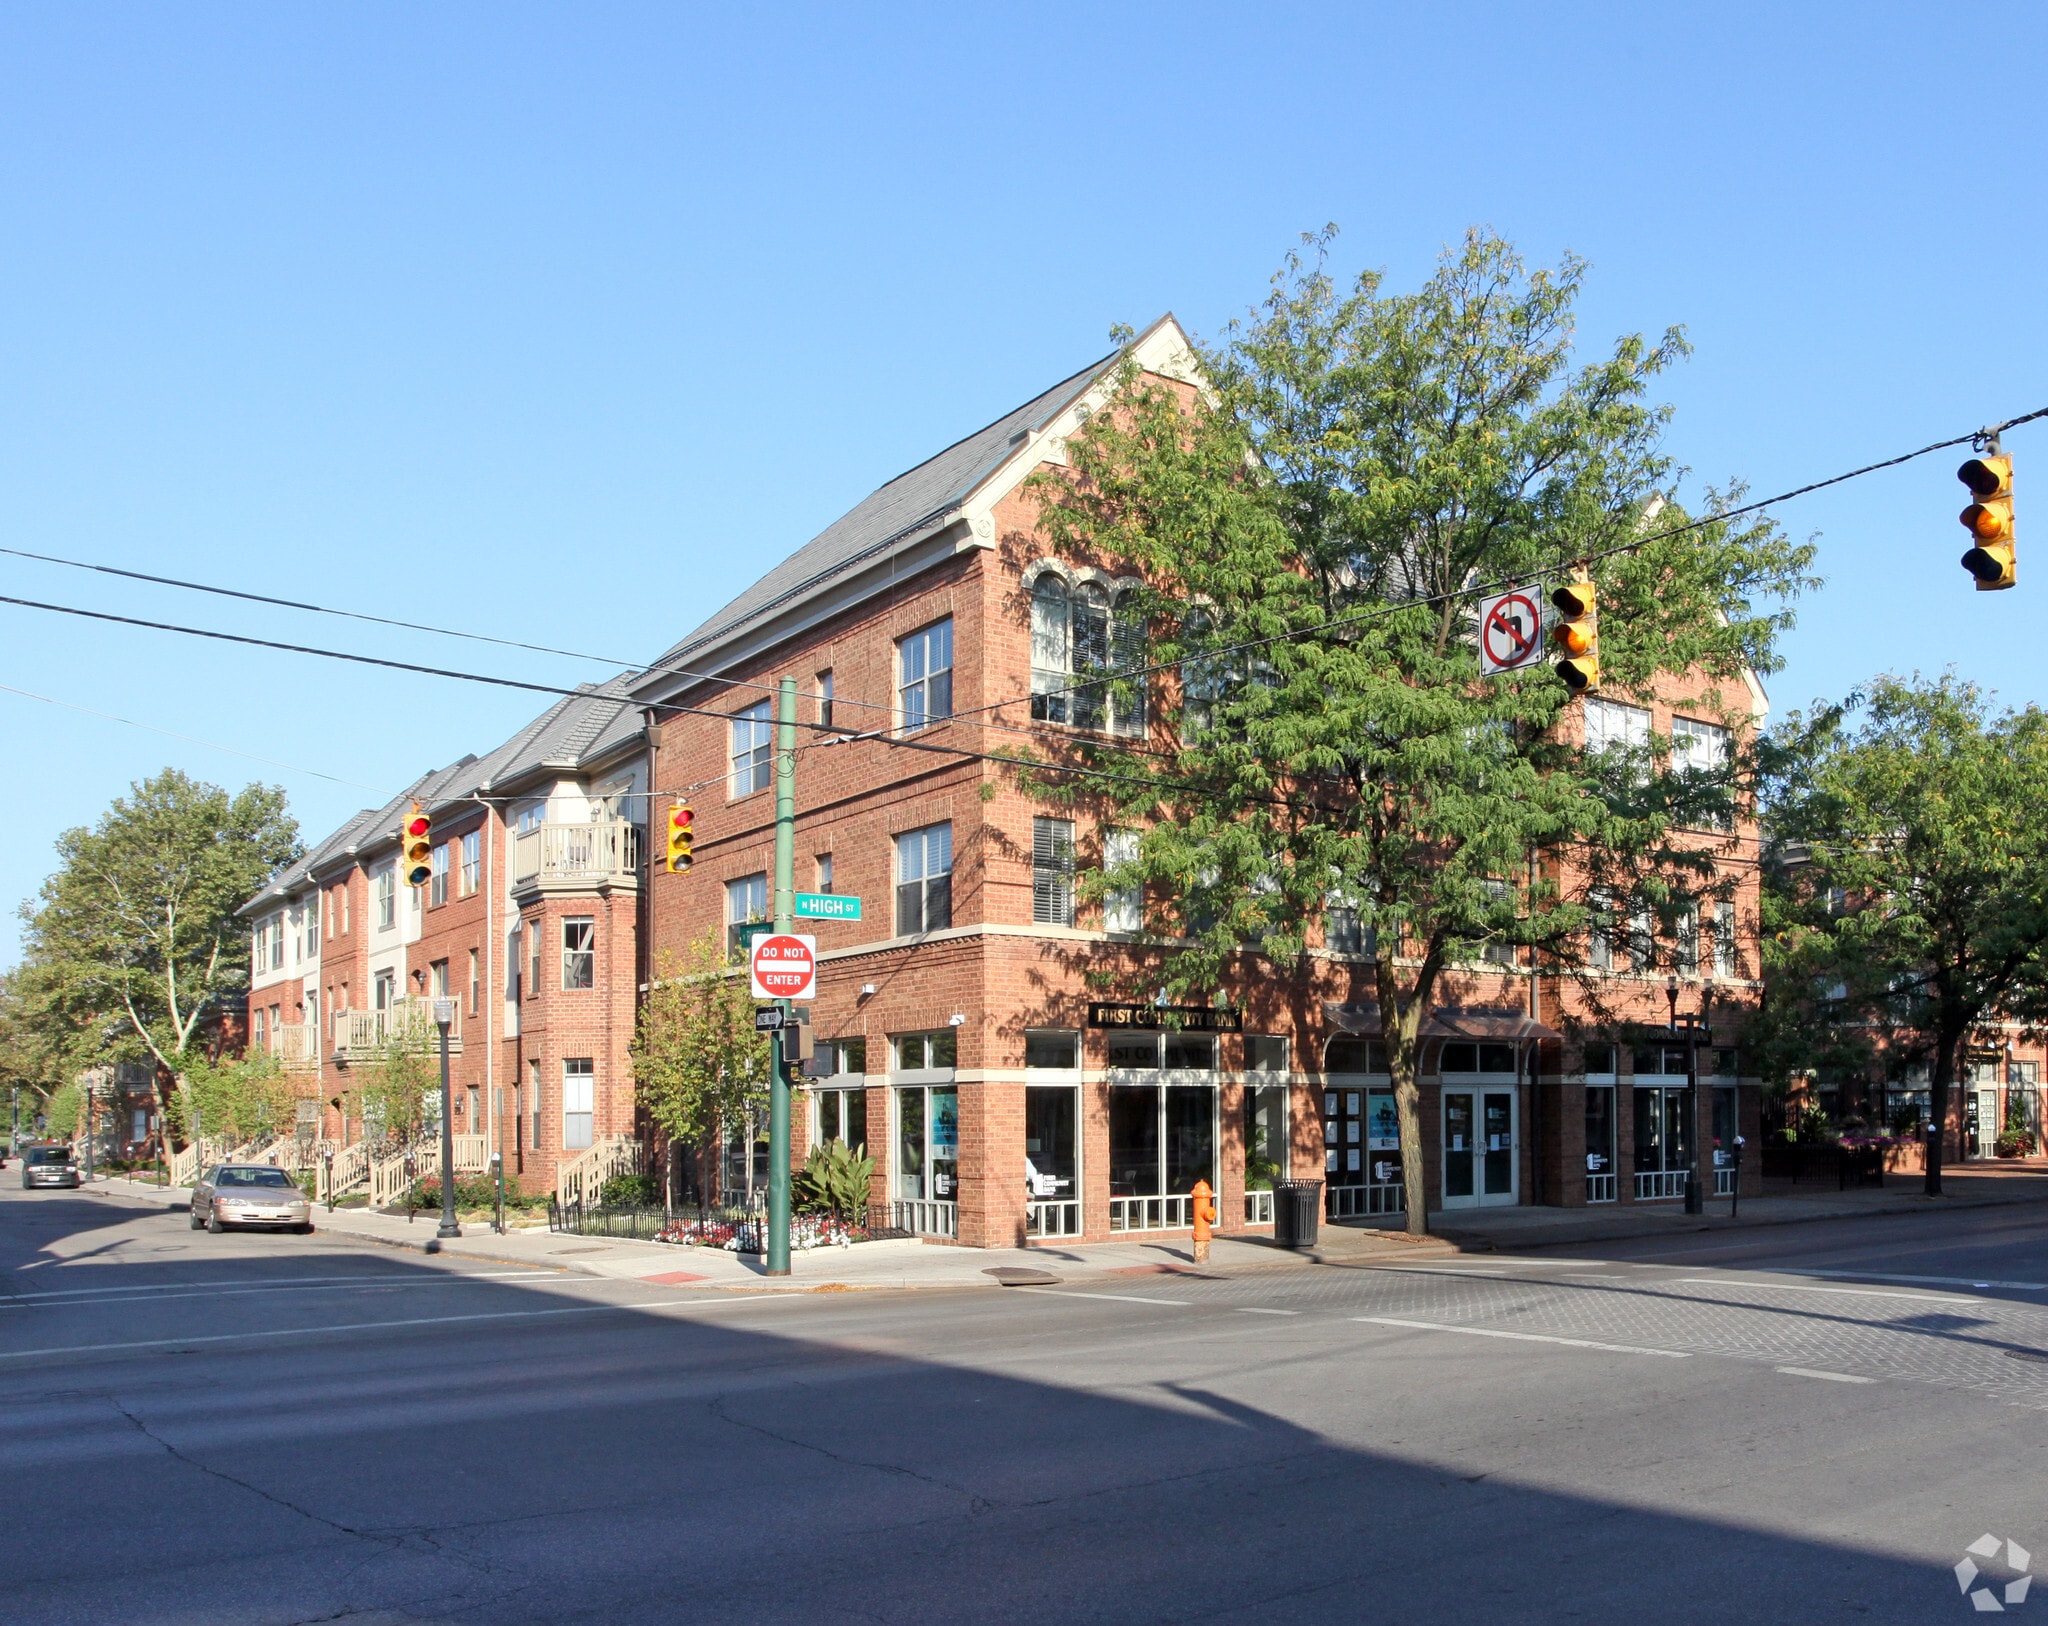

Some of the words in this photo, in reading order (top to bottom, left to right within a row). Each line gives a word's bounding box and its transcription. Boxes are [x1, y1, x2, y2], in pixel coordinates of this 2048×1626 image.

[802, 901, 808, 910] N
[809, 898, 843, 914] HIGH
[845, 904, 854, 912] ST
[762, 947, 777, 957] DO
[783, 947, 805, 957] NOT
[766, 975, 801, 985] ENTER
[757, 1014, 767, 1025] ONE
[768, 1013, 777, 1024] WAY
[1097, 1008, 1133, 1024] FIRST
[1206, 1012, 1237, 1027] BANK
